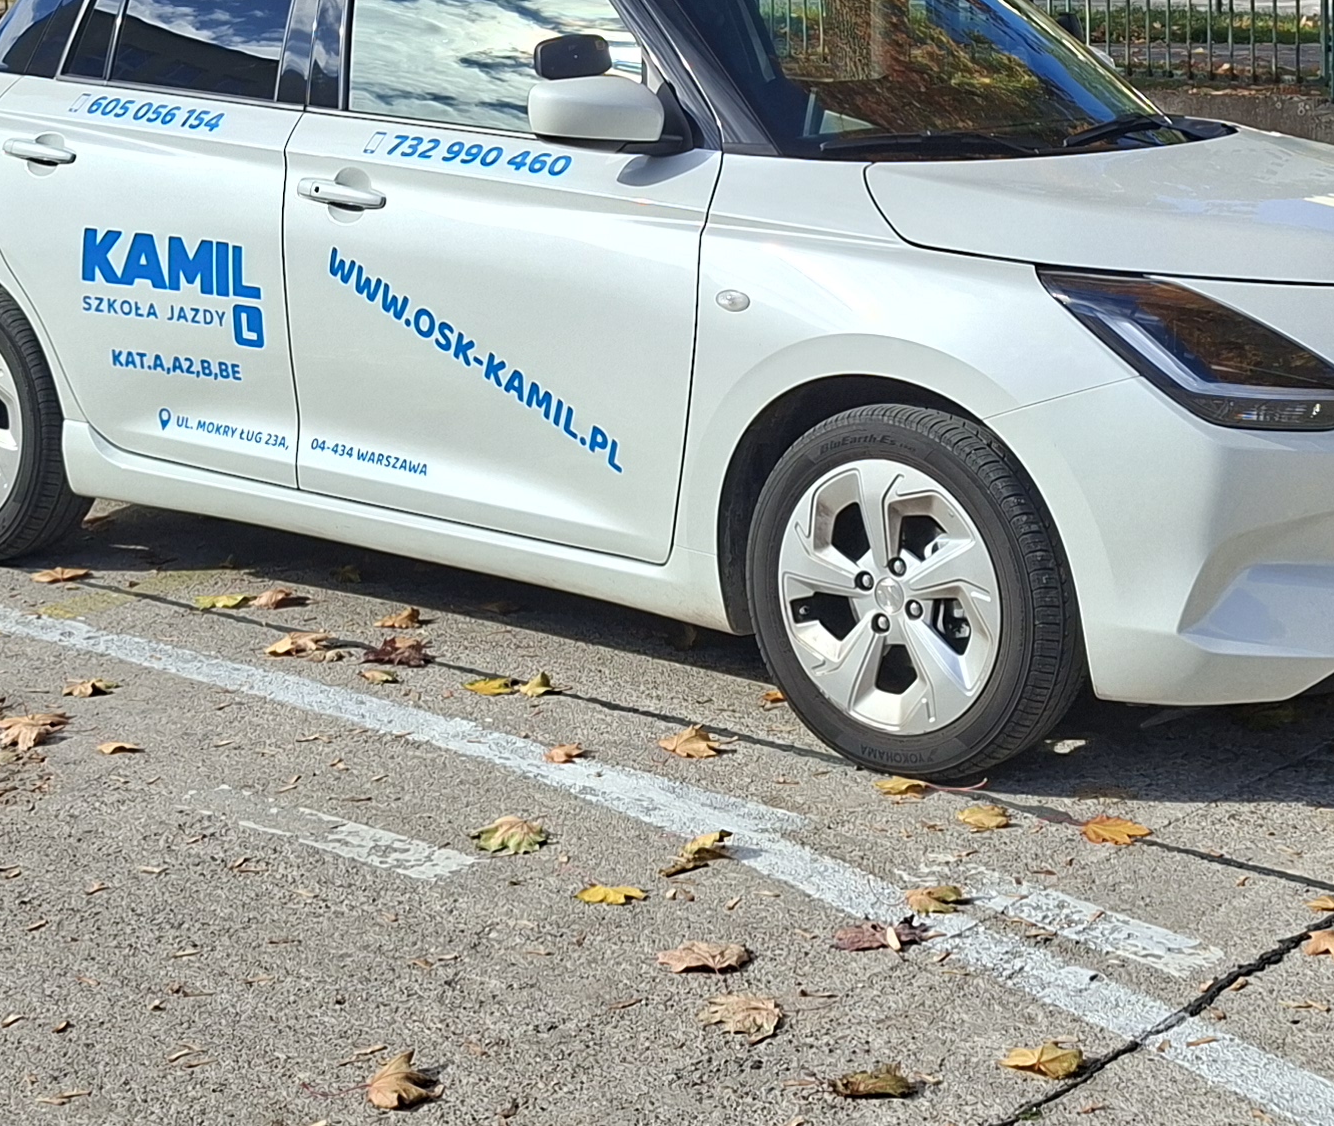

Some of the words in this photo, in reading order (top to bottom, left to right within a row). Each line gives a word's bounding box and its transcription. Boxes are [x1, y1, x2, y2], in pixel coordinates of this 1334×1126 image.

[87, 96, 132, 117] 605
[132, 102, 180, 125] 056
[181, 108, 225, 132] 154
[387, 134, 440, 159] 732
[442, 141, 503, 167] 990
[507, 150, 572, 176] 460
[82, 227, 261, 300] KAMIL
[82, 295, 158, 320] SZKOŁA
[167, 305, 225, 327] JAZDY
[240, 311, 258, 341] L
[112, 349, 242, 381] KAT.A,A2,B,BE
[329, 247, 623, 473] WWW.OSK-KAMIL.PL
[176, 415, 193, 430] UL.
[196, 420, 238, 439] MOKRY
[239, 429, 263, 444] ŁUG
[264, 433, 289, 451] 23A,
[310, 438, 354, 459] 04-434
[356, 448, 428, 476] WARSZAWA
[860, 744, 924, 764] YOKOHAMA
